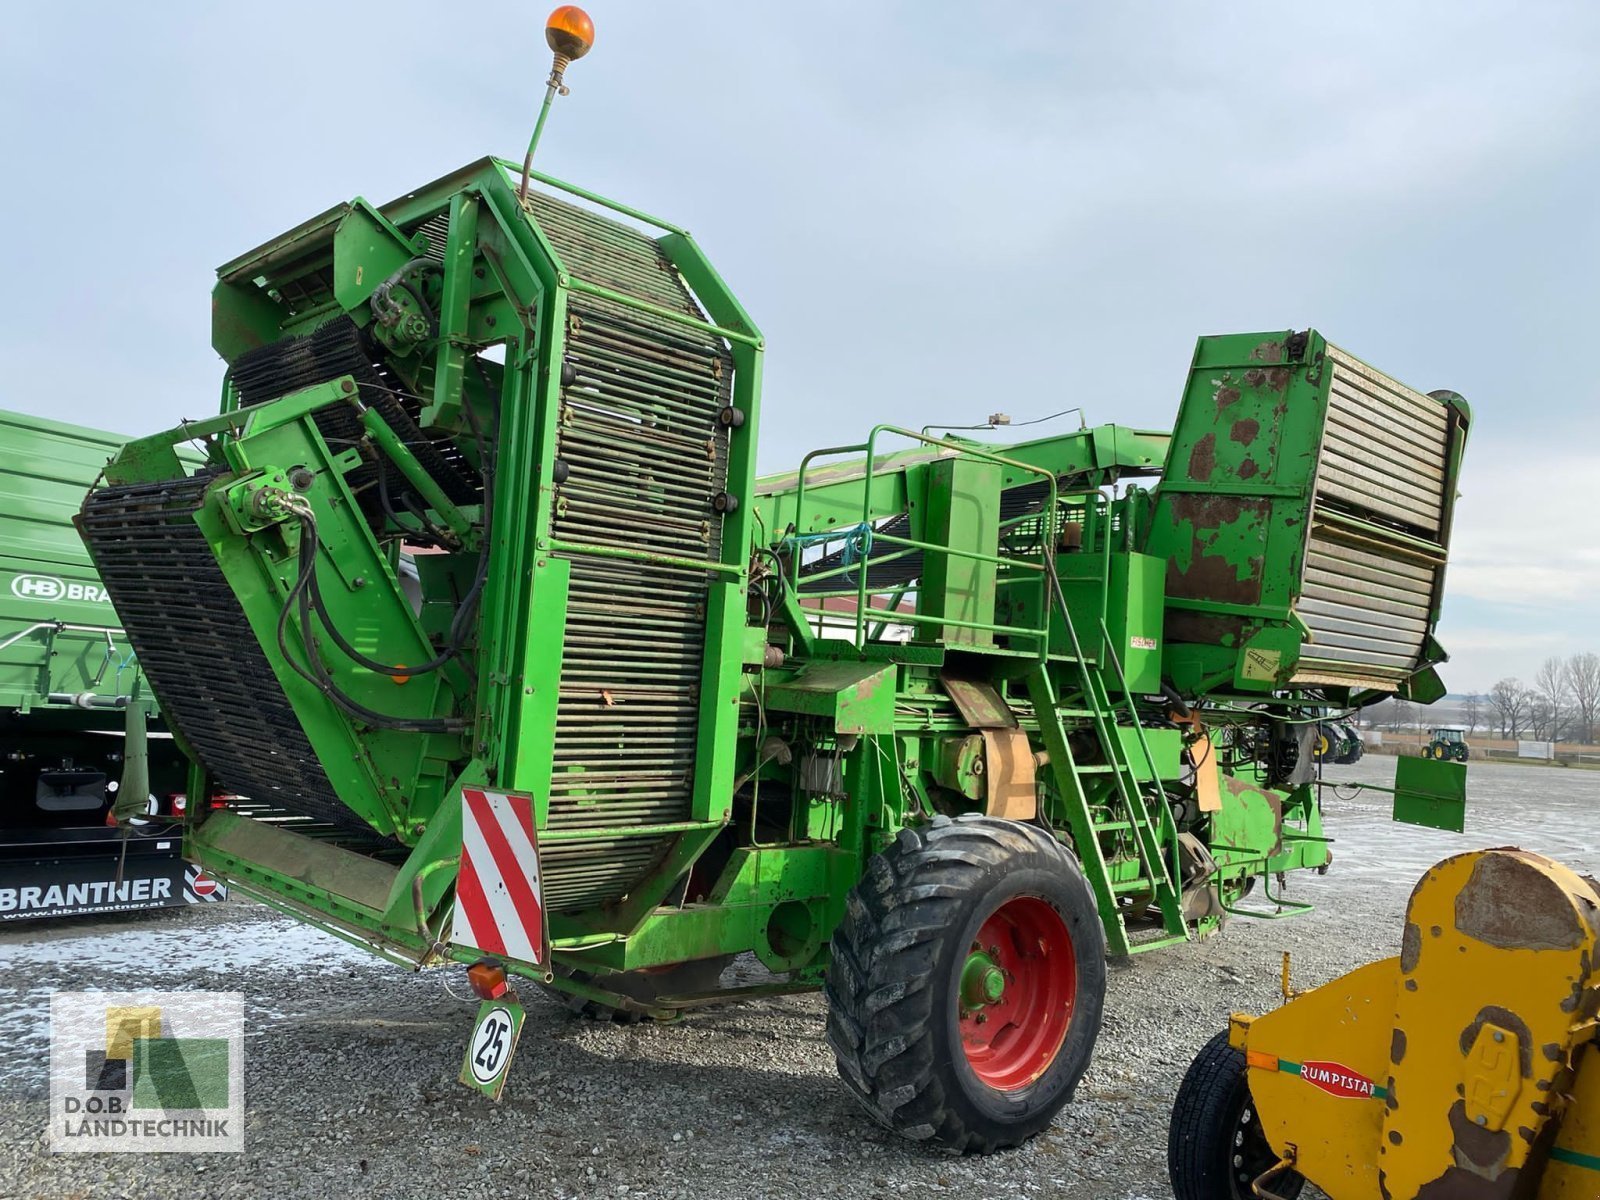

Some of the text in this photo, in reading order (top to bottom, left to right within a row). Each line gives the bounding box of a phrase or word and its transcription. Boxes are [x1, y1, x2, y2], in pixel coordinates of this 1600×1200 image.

[21, 578, 58, 597] HB
[0, 877, 172, 912] BRANTNER
[3, 900, 165, 920] www.hb-brantner.at
[475, 1018, 508, 1072] 25
